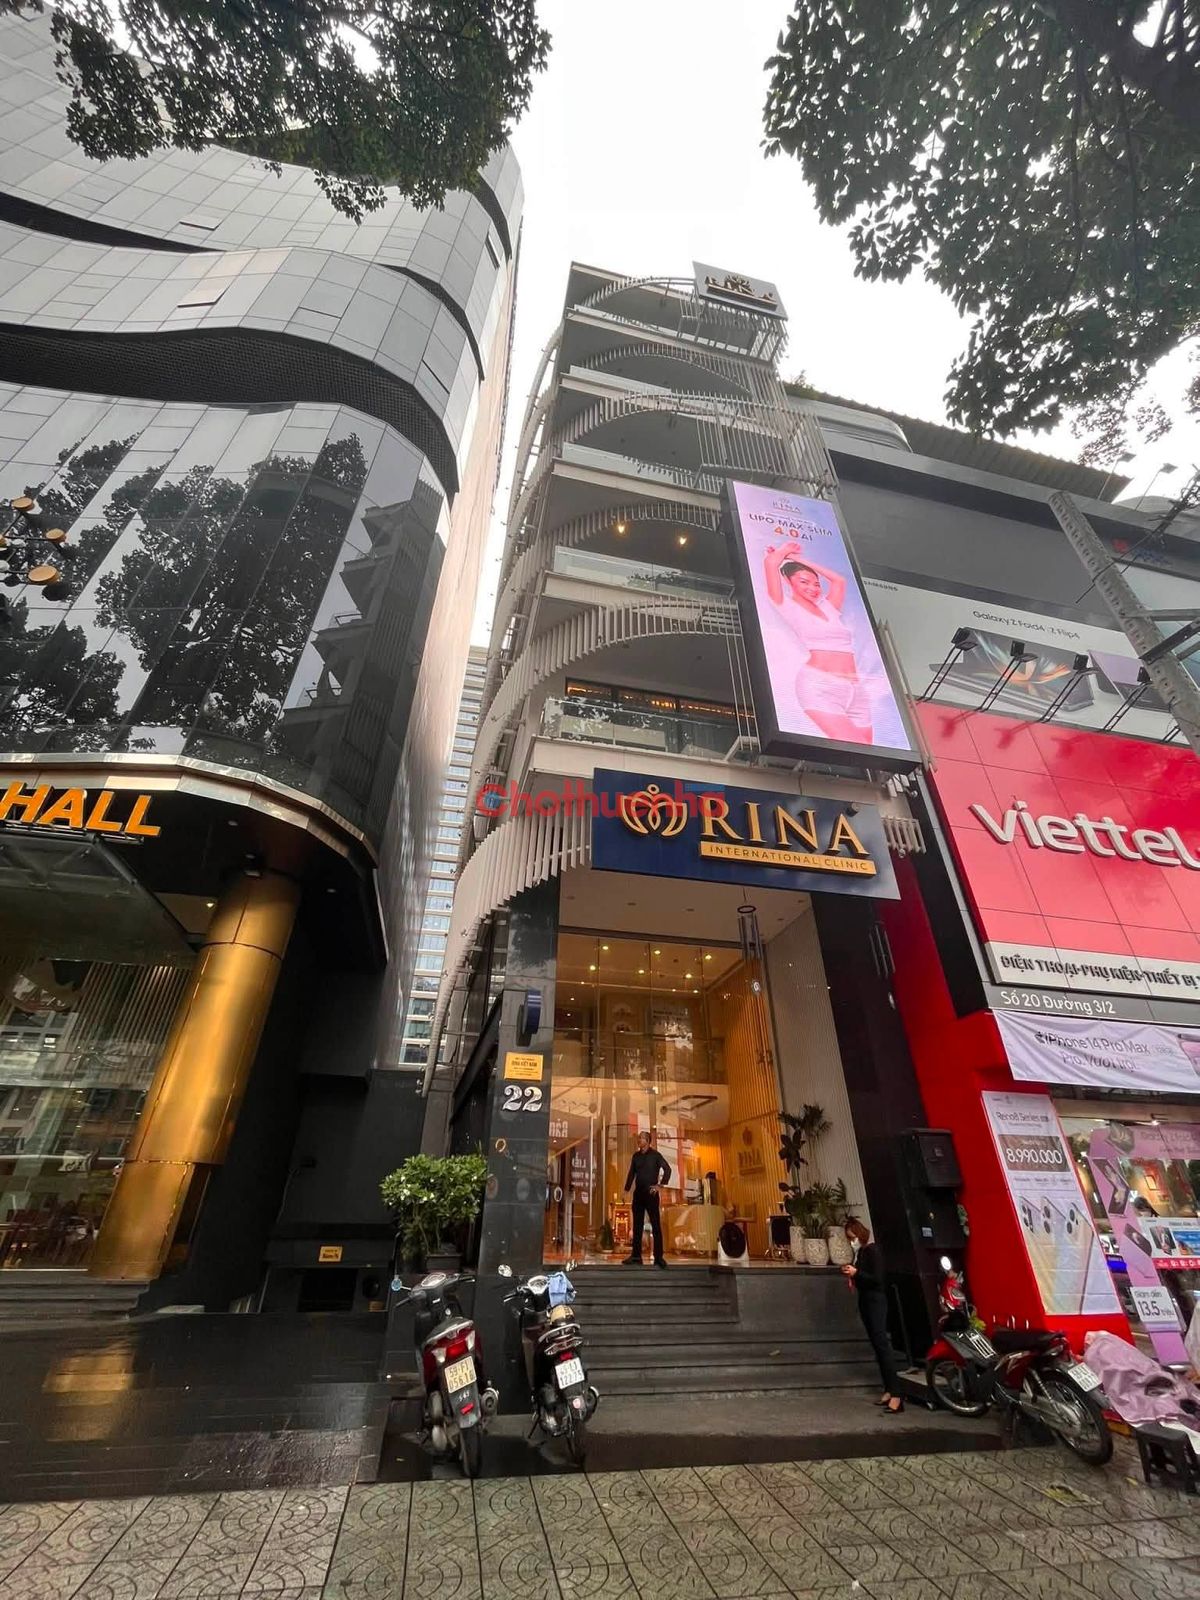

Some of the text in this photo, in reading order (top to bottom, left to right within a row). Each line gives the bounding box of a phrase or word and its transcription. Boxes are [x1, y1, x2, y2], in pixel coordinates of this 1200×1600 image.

[749, 513, 775, 524] LIPO
[777, 519, 804, 531] MAX
[807, 525, 833, 536] SLIM
[774, 526, 799, 538] 4.0
[972, 610, 1009, 626] Galaxy
[1010, 618, 1018, 626] Z
[1018, 620, 1046, 632] Fold4
[1057, 628, 1081, 640] Flip4
[0, 779, 162, 837] HALL
[697, 795, 870, 857] RINA
[709, 845, 868, 871] INTERNATIONAL CLINIC
[1000, 954, 1035, 973] ĐIỆN
[1181, 974, 1199, 990] BỊ
[1000, 989, 1117, 1015] Số 20 Đường 3/2
[1044, 1033, 1087, 1051] iPhone
[1086, 1036, 1101, 1049] 14
[1102, 1038, 1124, 1053] Pro
[1124, 1040, 1151, 1056] Max
[502, 1084, 543, 1112] 22
[996, 1111, 1020, 1122] Reno8
[1020, 1112, 1040, 1122] Series
[1006, 1147, 1063, 1165] 8.990.000
